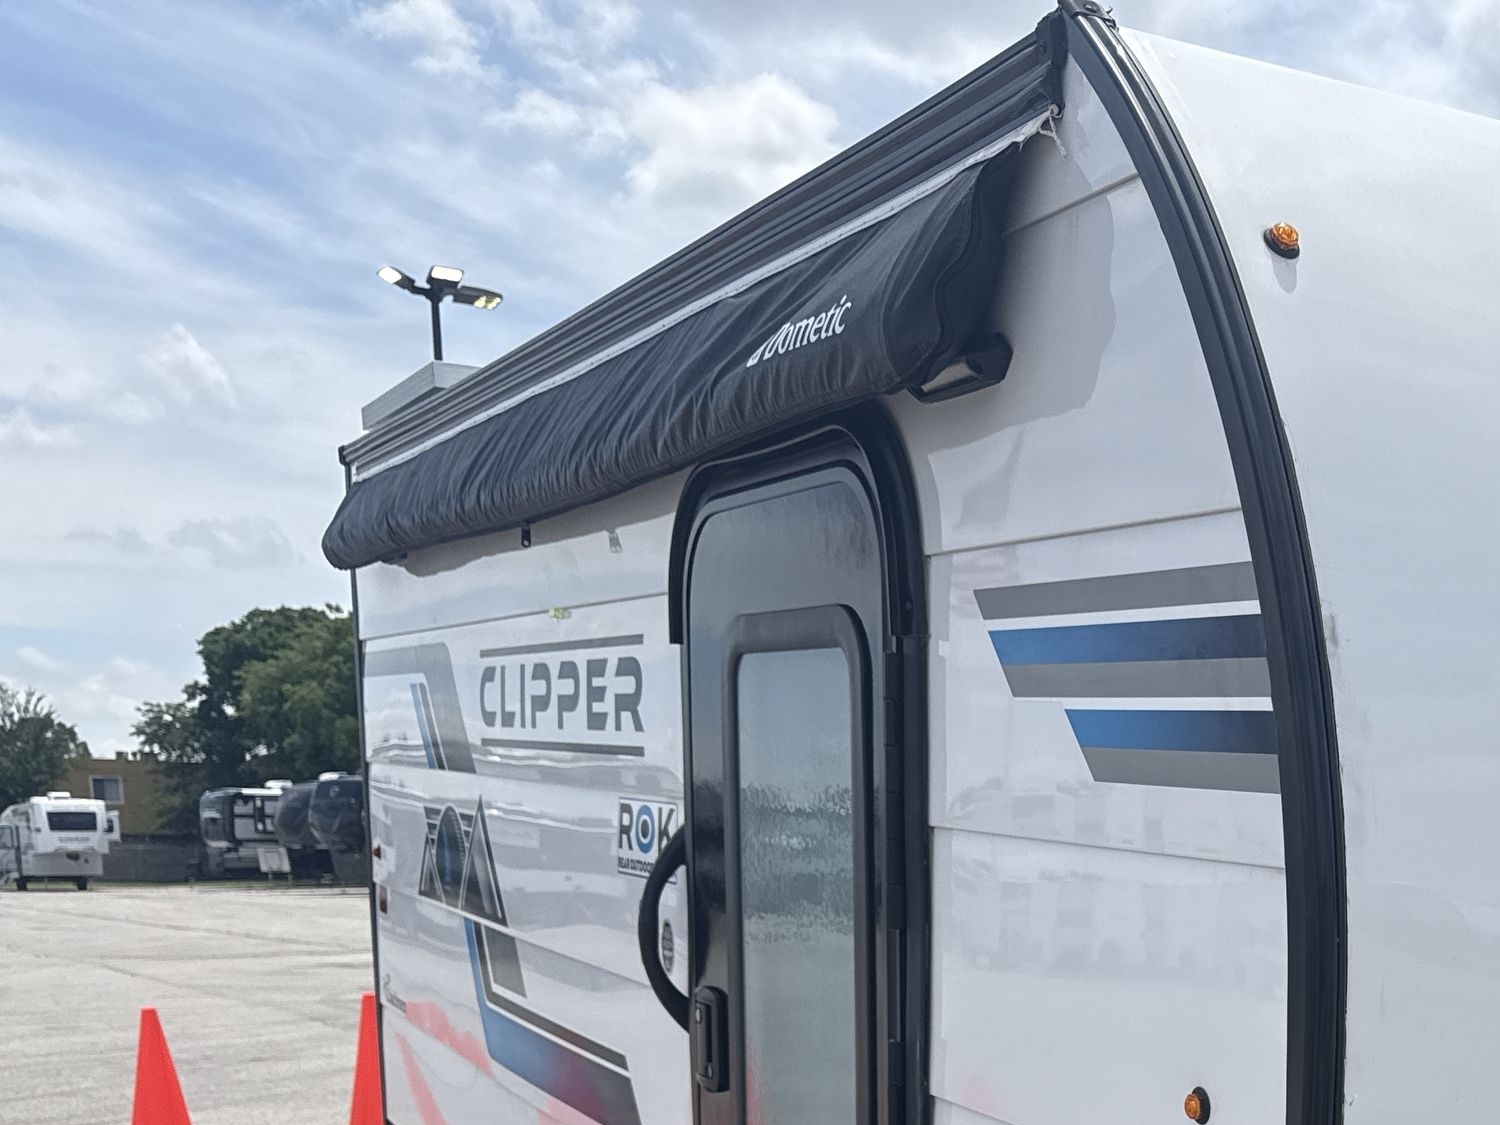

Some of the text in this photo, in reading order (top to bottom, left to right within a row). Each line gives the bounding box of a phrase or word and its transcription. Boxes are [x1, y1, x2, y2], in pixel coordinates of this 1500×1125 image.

[763, 294, 852, 361] Dometic
[479, 656, 645, 732] CLIPPER
[619, 803, 676, 856] ROK
